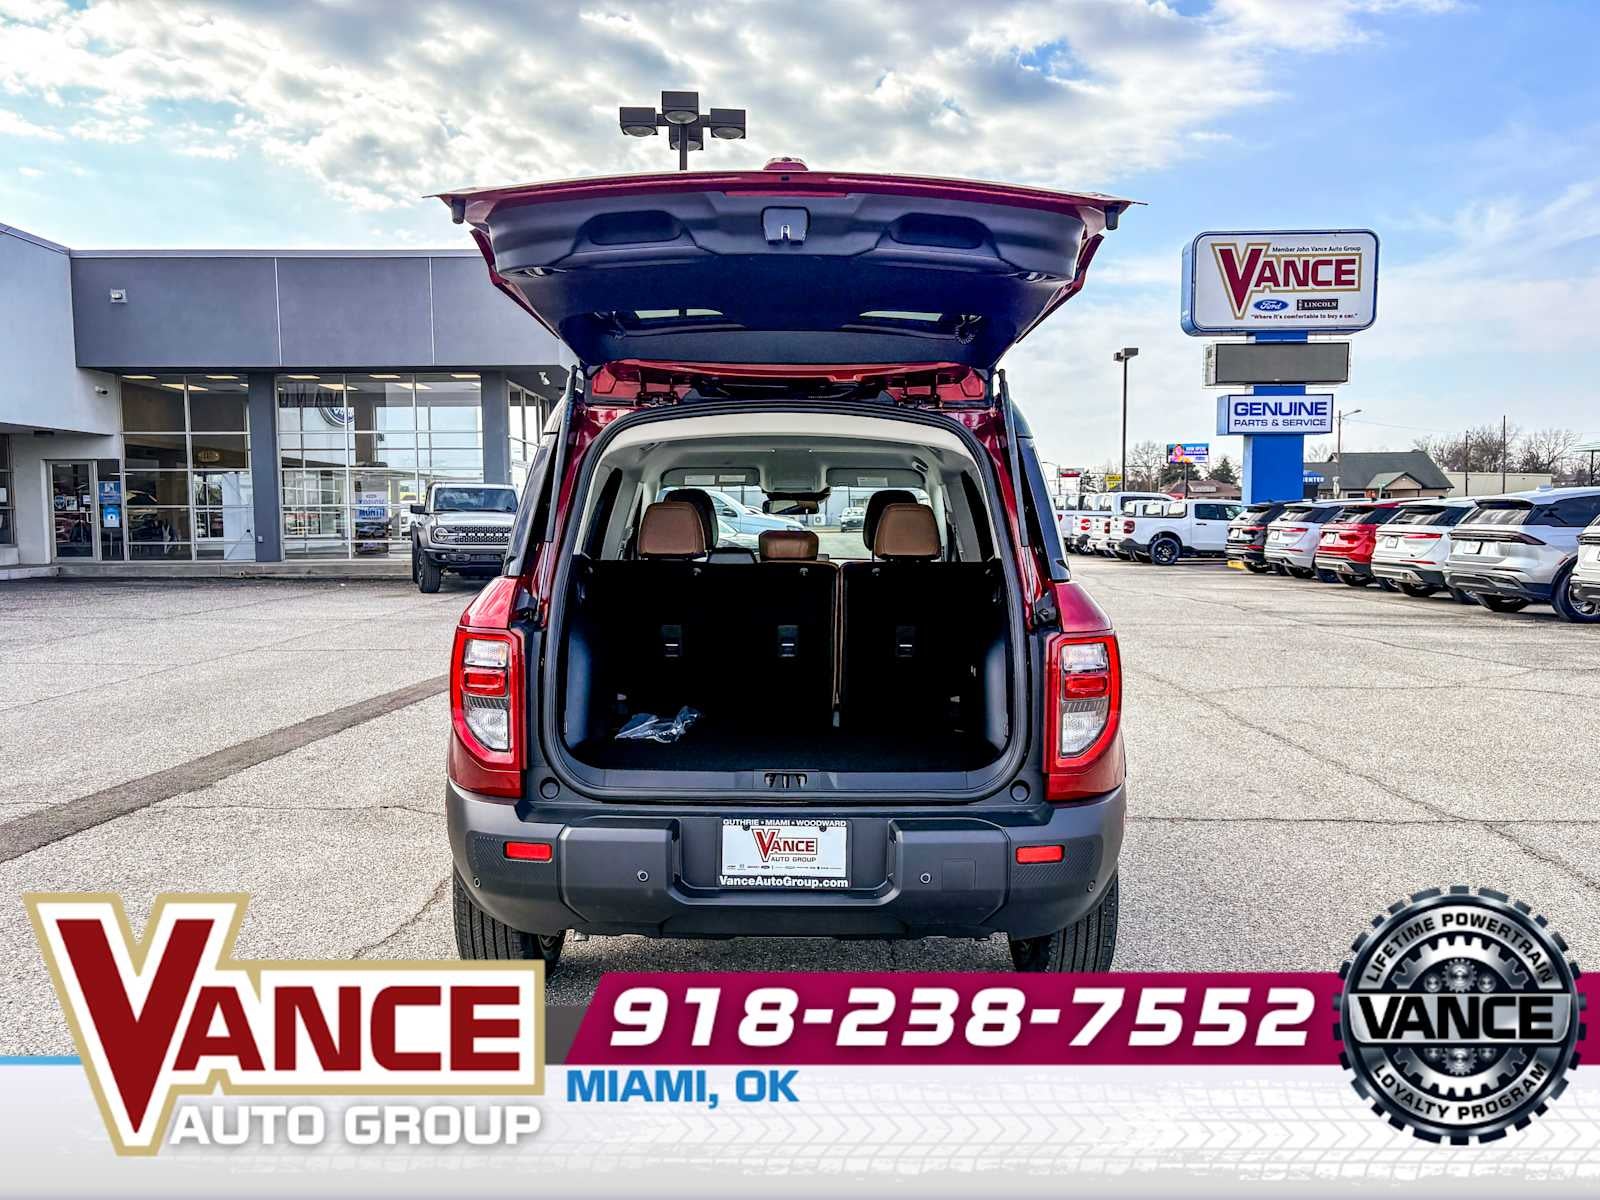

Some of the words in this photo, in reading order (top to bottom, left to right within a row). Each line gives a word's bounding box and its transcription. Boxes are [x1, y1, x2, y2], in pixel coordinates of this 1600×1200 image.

[1219, 249, 1356, 312] VANCE
[1259, 300, 1283, 310] Ford
[1234, 401, 1328, 416] GENUINE
[1234, 419, 1268, 427] PARTS
[1271, 419, 1279, 427] &
[1282, 418, 1326, 427] SERVICE
[723, 819, 760, 827] GUTHRIE
[765, 819, 791, 827] MIAMI
[796, 819, 847, 828] WOODWARD
[755, 831, 816, 860] VANCE
[719, 875, 849, 889] VanceAutoGroup.com
